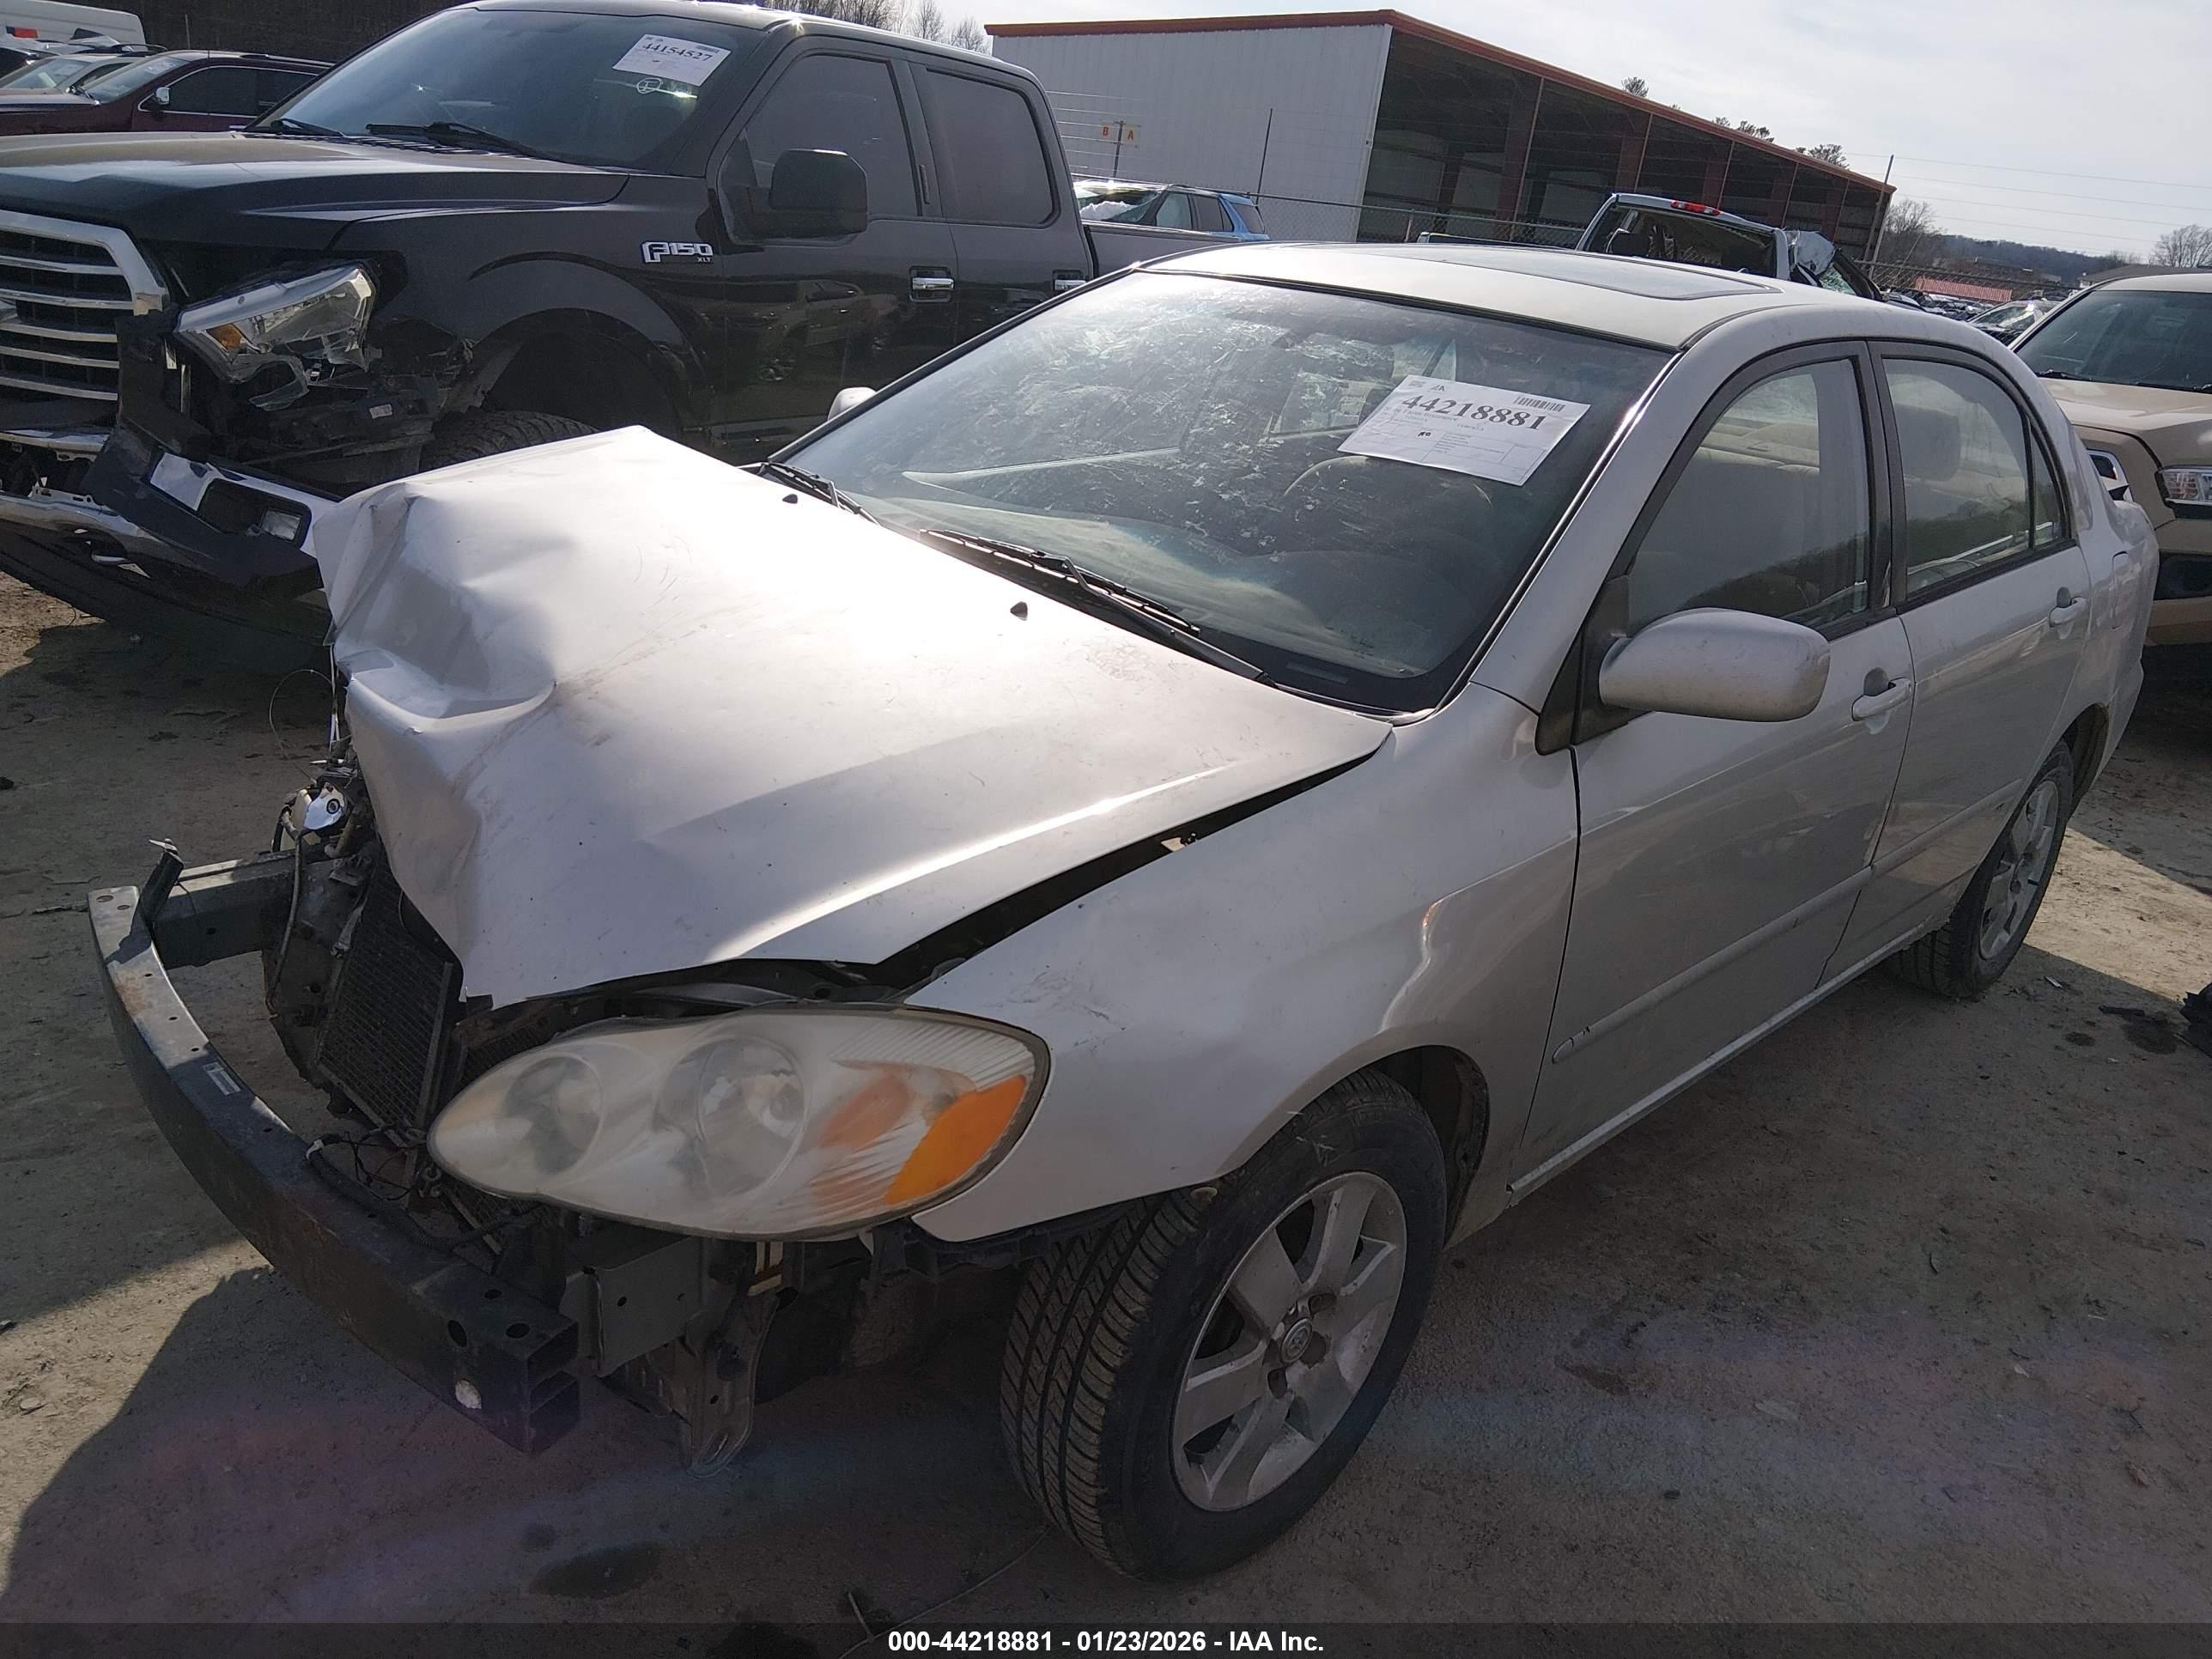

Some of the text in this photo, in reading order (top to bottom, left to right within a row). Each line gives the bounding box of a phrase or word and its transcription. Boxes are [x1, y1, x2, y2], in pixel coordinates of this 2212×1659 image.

[642, 43, 713, 62] 44154527
[1103, 126, 1109, 136] B
[1127, 131, 1133, 140] A
[1401, 394, 1547, 431] 44218881
